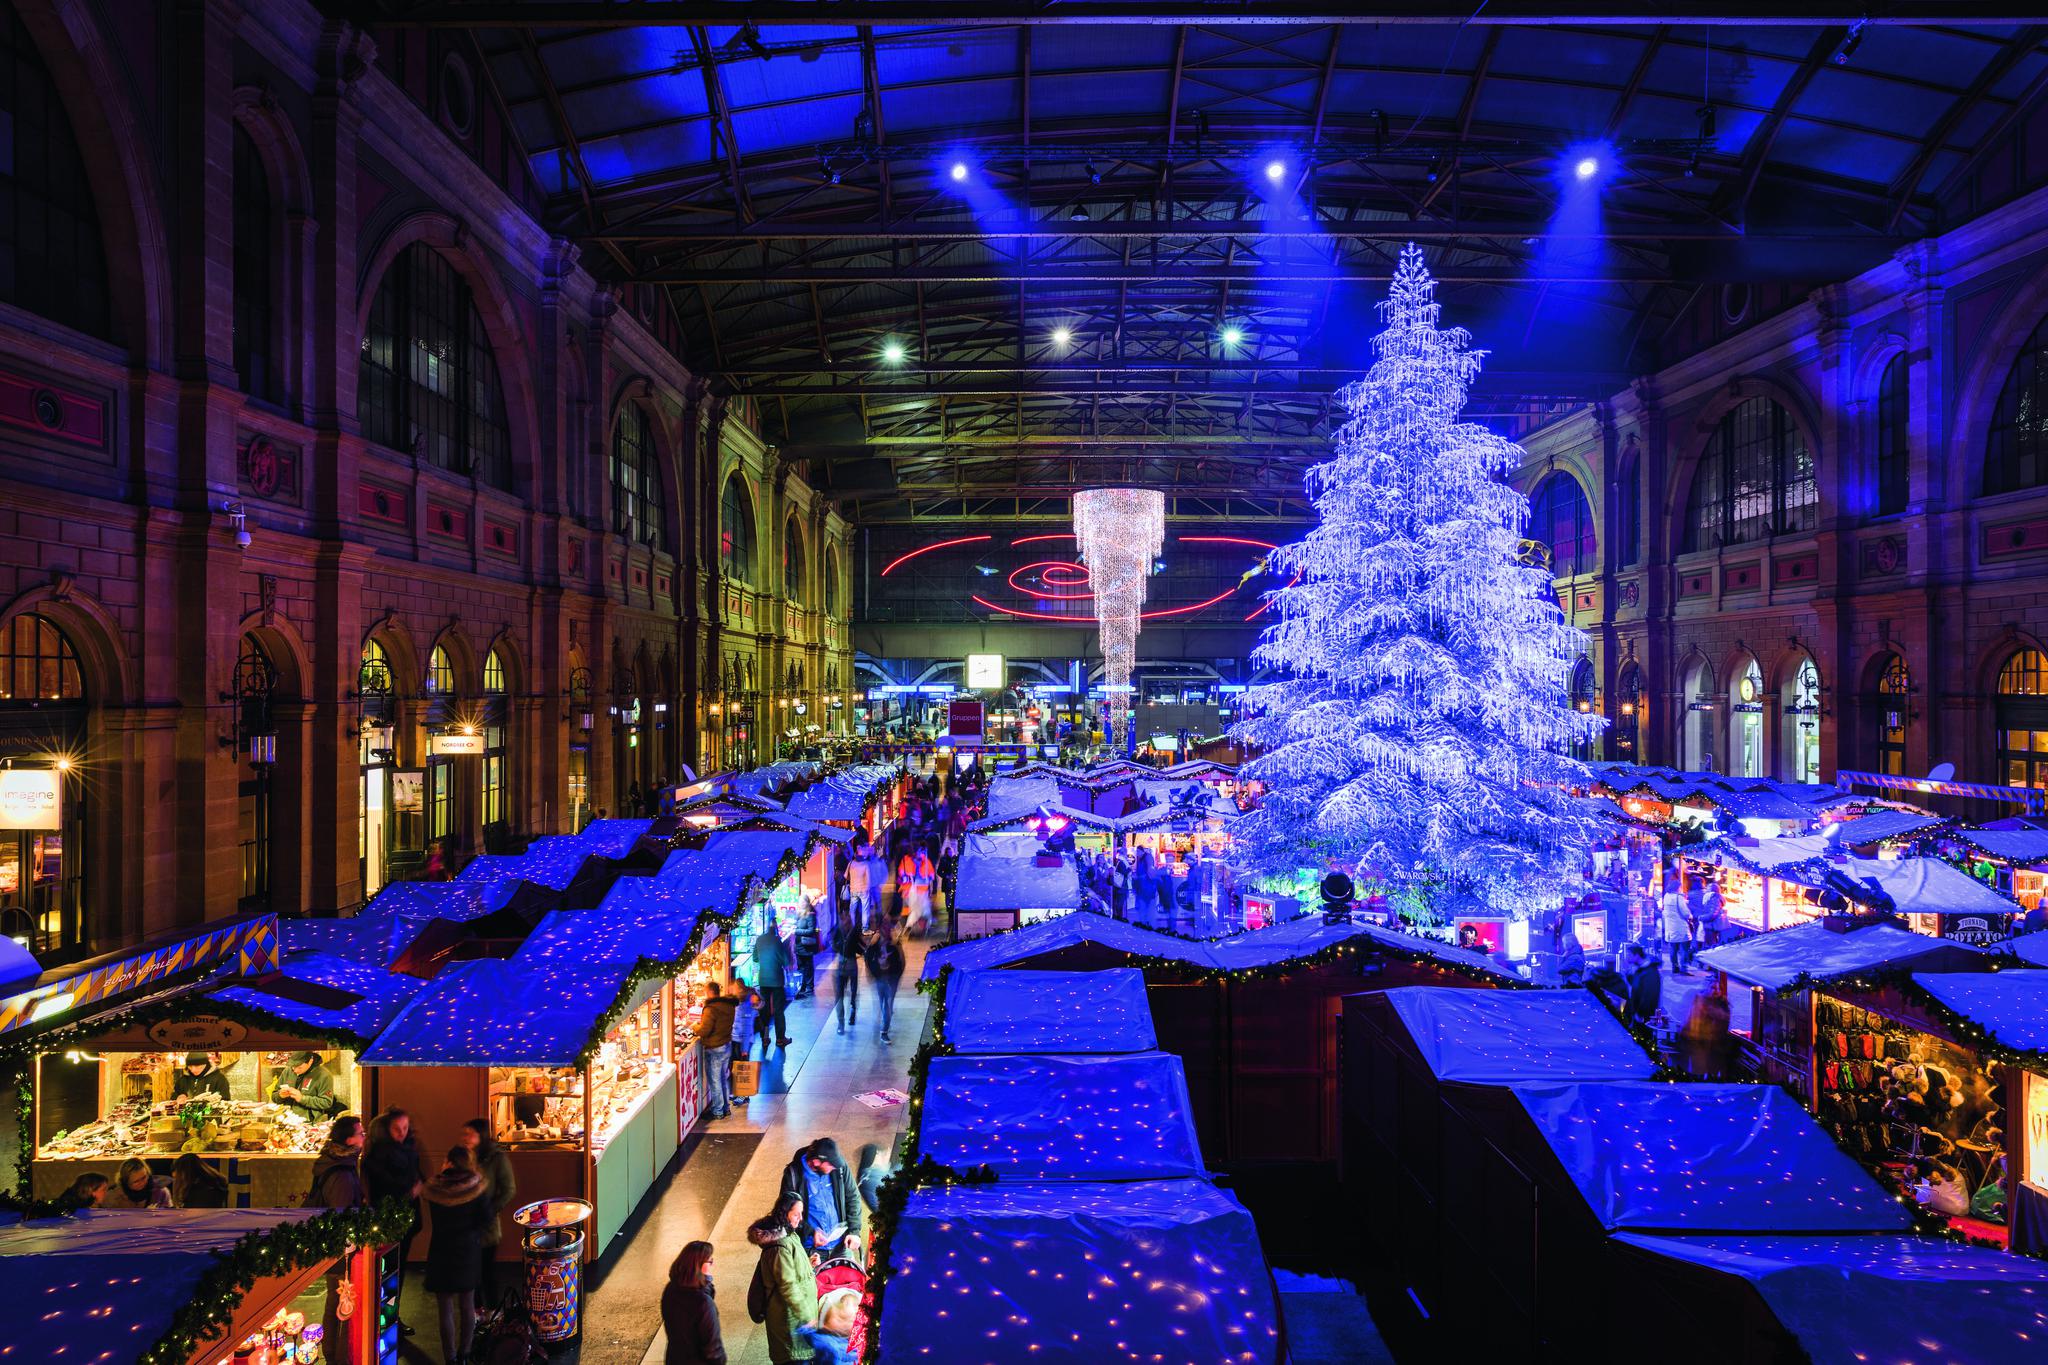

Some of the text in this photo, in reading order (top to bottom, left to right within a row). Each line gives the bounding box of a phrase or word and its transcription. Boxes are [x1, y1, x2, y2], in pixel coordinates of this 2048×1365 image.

[5, 791, 54, 802] imagine
[1961, 918, 1986, 927] TORNADO
[103, 970, 135, 987] BUON
